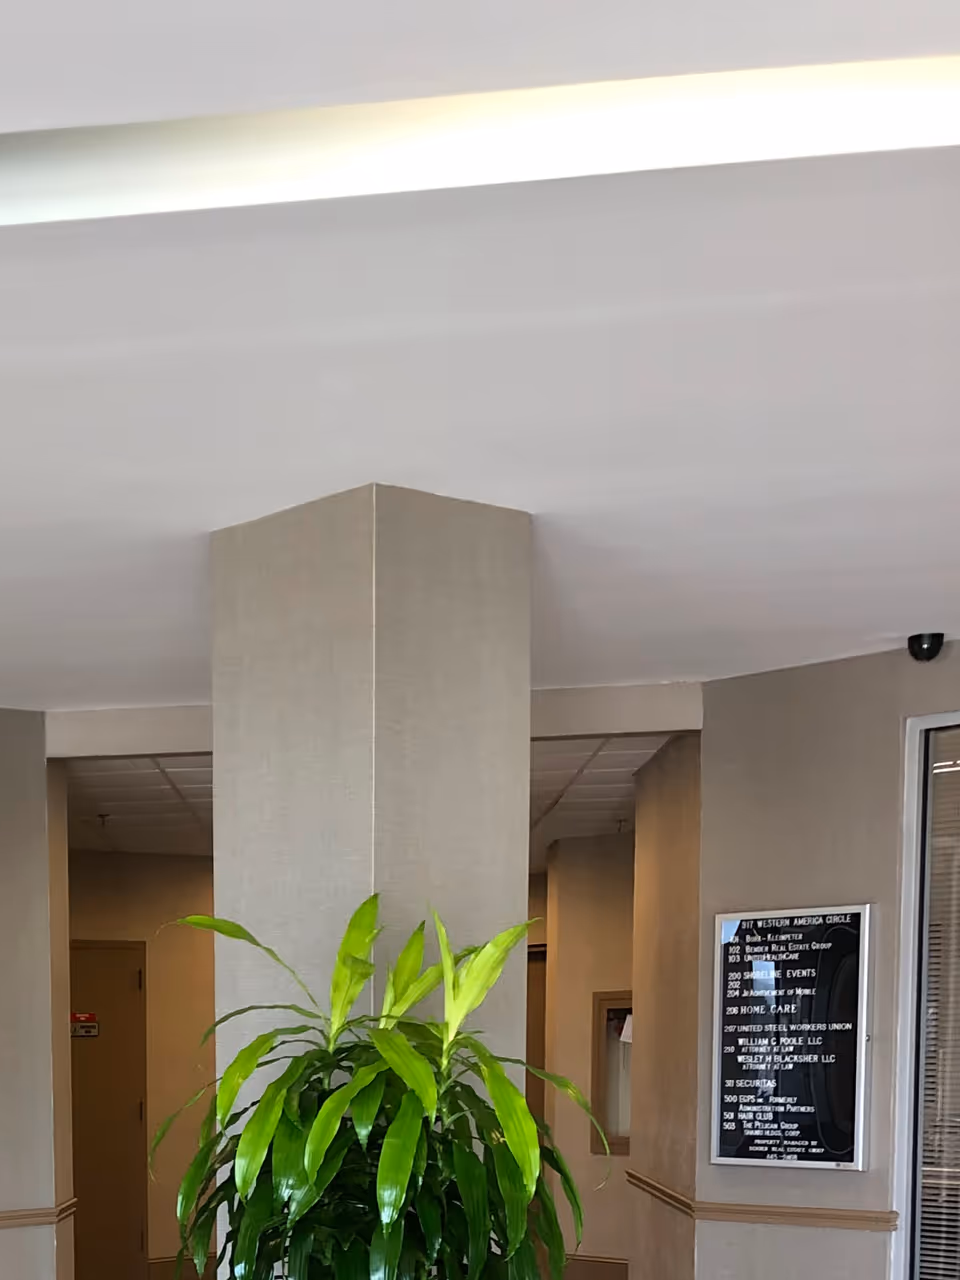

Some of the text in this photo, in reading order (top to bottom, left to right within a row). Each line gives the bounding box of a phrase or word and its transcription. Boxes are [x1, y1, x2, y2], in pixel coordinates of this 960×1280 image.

[757, 919, 790, 928] WESTERN
[793, 916, 824, 926] AMERICA
[825, 914, 851, 924] CIRCLE
[728, 945, 740, 954] 102
[771, 943, 786, 952] REAL
[788, 943, 810, 951] ESTATE
[728, 954, 740, 963] 103
[728, 971, 741, 980] 200
[786, 968, 816, 978] EVENTS
[727, 981, 740, 989] 202
[726, 989, 739, 998] 204
[740, 1005, 766, 1014] HOME
[770, 1004, 797, 1014] CARE
[737, 1024, 763, 1032] UNITED
[764, 1024, 788, 1032] STEEL
[789, 1023, 827, 1031] WORKERS
[828, 1022, 852, 1030] UNION
[737, 1037, 768, 1046] WILLIAM
[780, 1037, 804, 1045] POOLE
[808, 1036, 823, 1045] LLC
[737, 1055, 763, 1063] WESLEY
[774, 1054, 818, 1063] BLACKSHER
[822, 1054, 836, 1063] LLC
[736, 1079, 777, 1088] SECURITAS
[724, 1095, 738, 1103] 500
[738, 1112, 754, 1120] HAIR
[755, 1112, 773, 1120] CLUB
